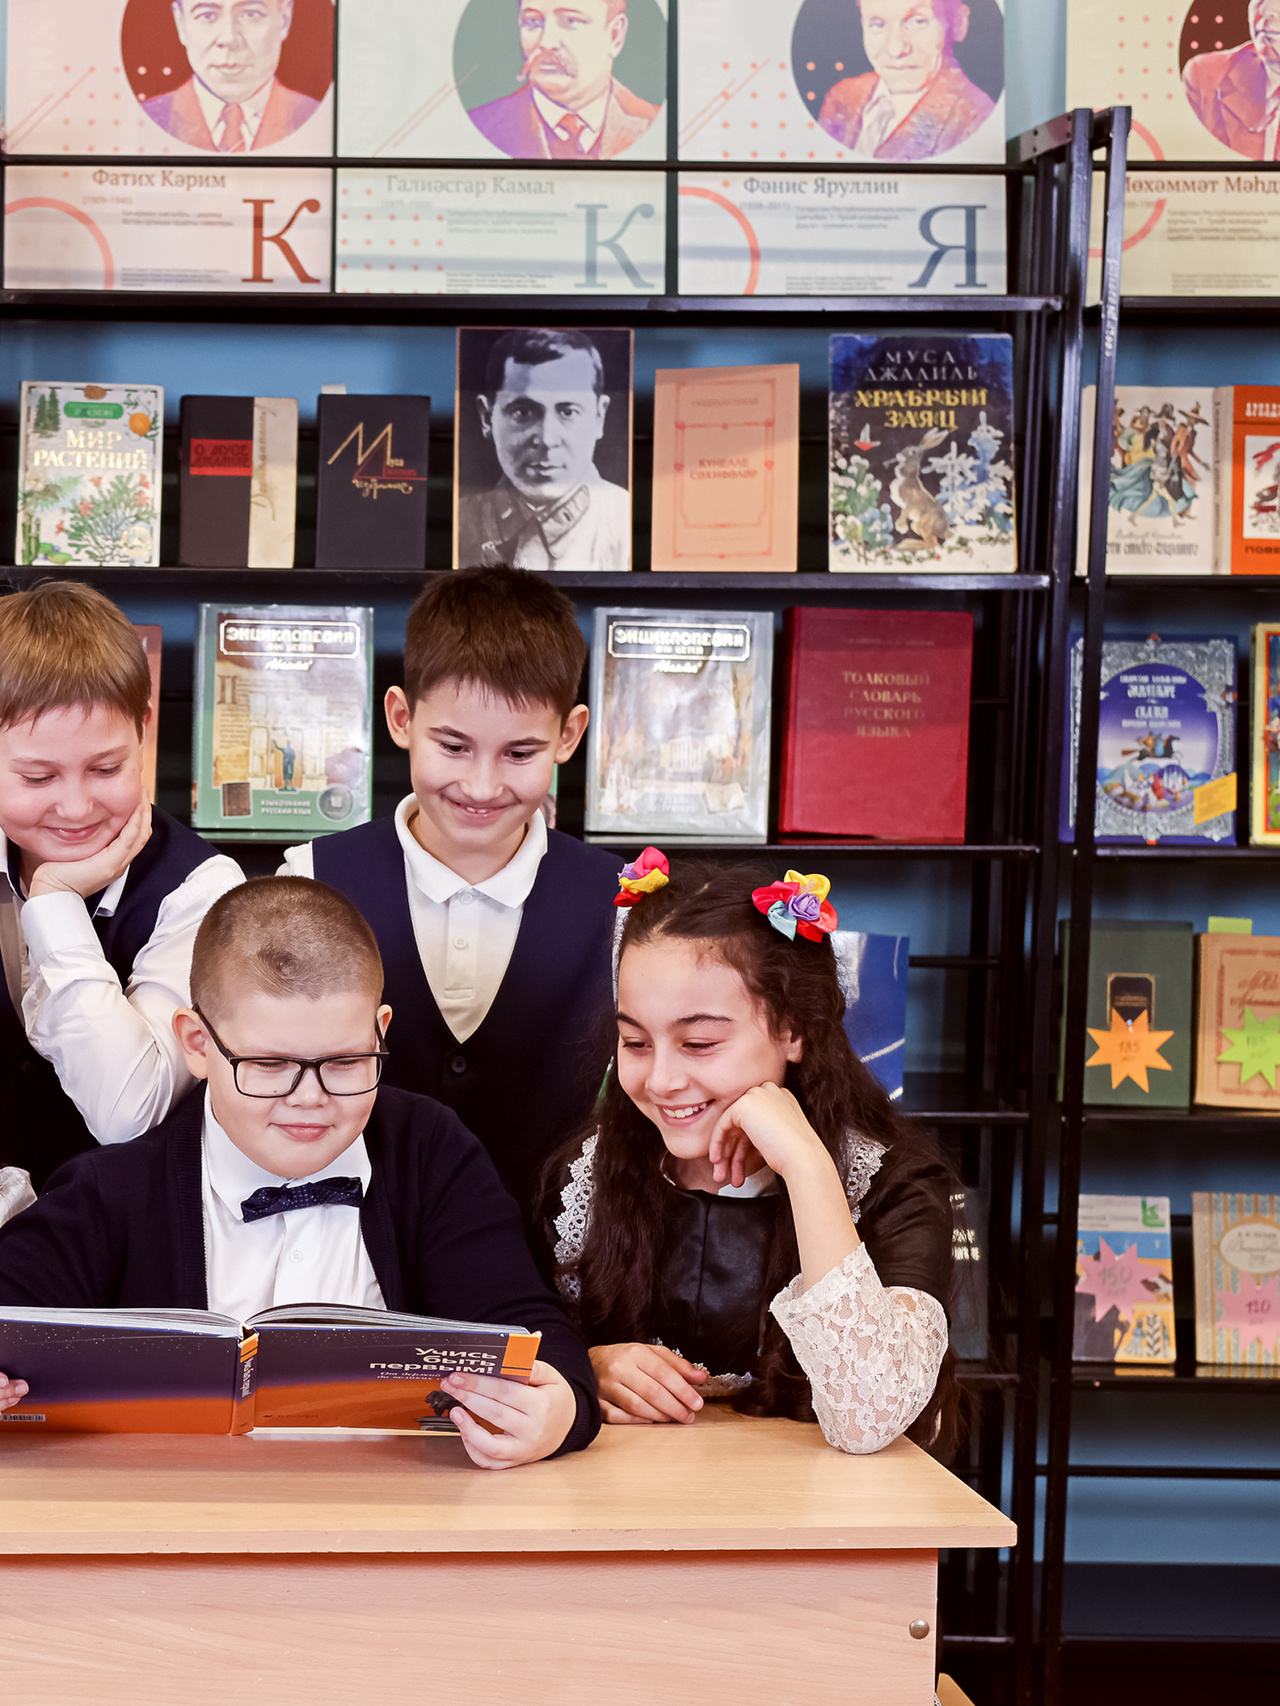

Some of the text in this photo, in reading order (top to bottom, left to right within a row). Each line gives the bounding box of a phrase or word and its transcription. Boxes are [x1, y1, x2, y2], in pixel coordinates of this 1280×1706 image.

[92, 169, 226, 191] Фатих Кәрим
[386, 175, 555, 198] Галиәсгар Камал
[743, 177, 899, 198] Фәнис Яруллин
[241, 198, 321, 284] К
[574, 203, 655, 289] К
[907, 204, 987, 288] Я
[886, 350, 956, 364] МУСА
[865, 366, 978, 381] ДЖАЛИЛЬ
[854, 387, 988, 407] ХРАБРЫЙ
[884, 409, 959, 432] ЗАЯЦ
[66, 429, 122, 449] МИР
[33, 449, 148, 470] РАСТЕНИЙ
[226, 627, 354, 644] ЭНЦИКЛОПЕДИЯ
[615, 629, 744, 647] ЭНЦИКЛОПЕДИЯ
[841, 670, 931, 685] ТОЛКОВЫЙ
[849, 689, 922, 703] СЛОВАРЬ
[843, 707, 926, 720] РУССКОГО
[856, 725, 911, 738] ЯЗЫКА
[261, 807, 292, 815] РУССКИЙ
[1098, 1265, 1133, 1287] 150
[415, 1347, 498, 1359] Учись
[423, 1356, 496, 1367] быть
[370, 1363, 493, 1374] первым!
